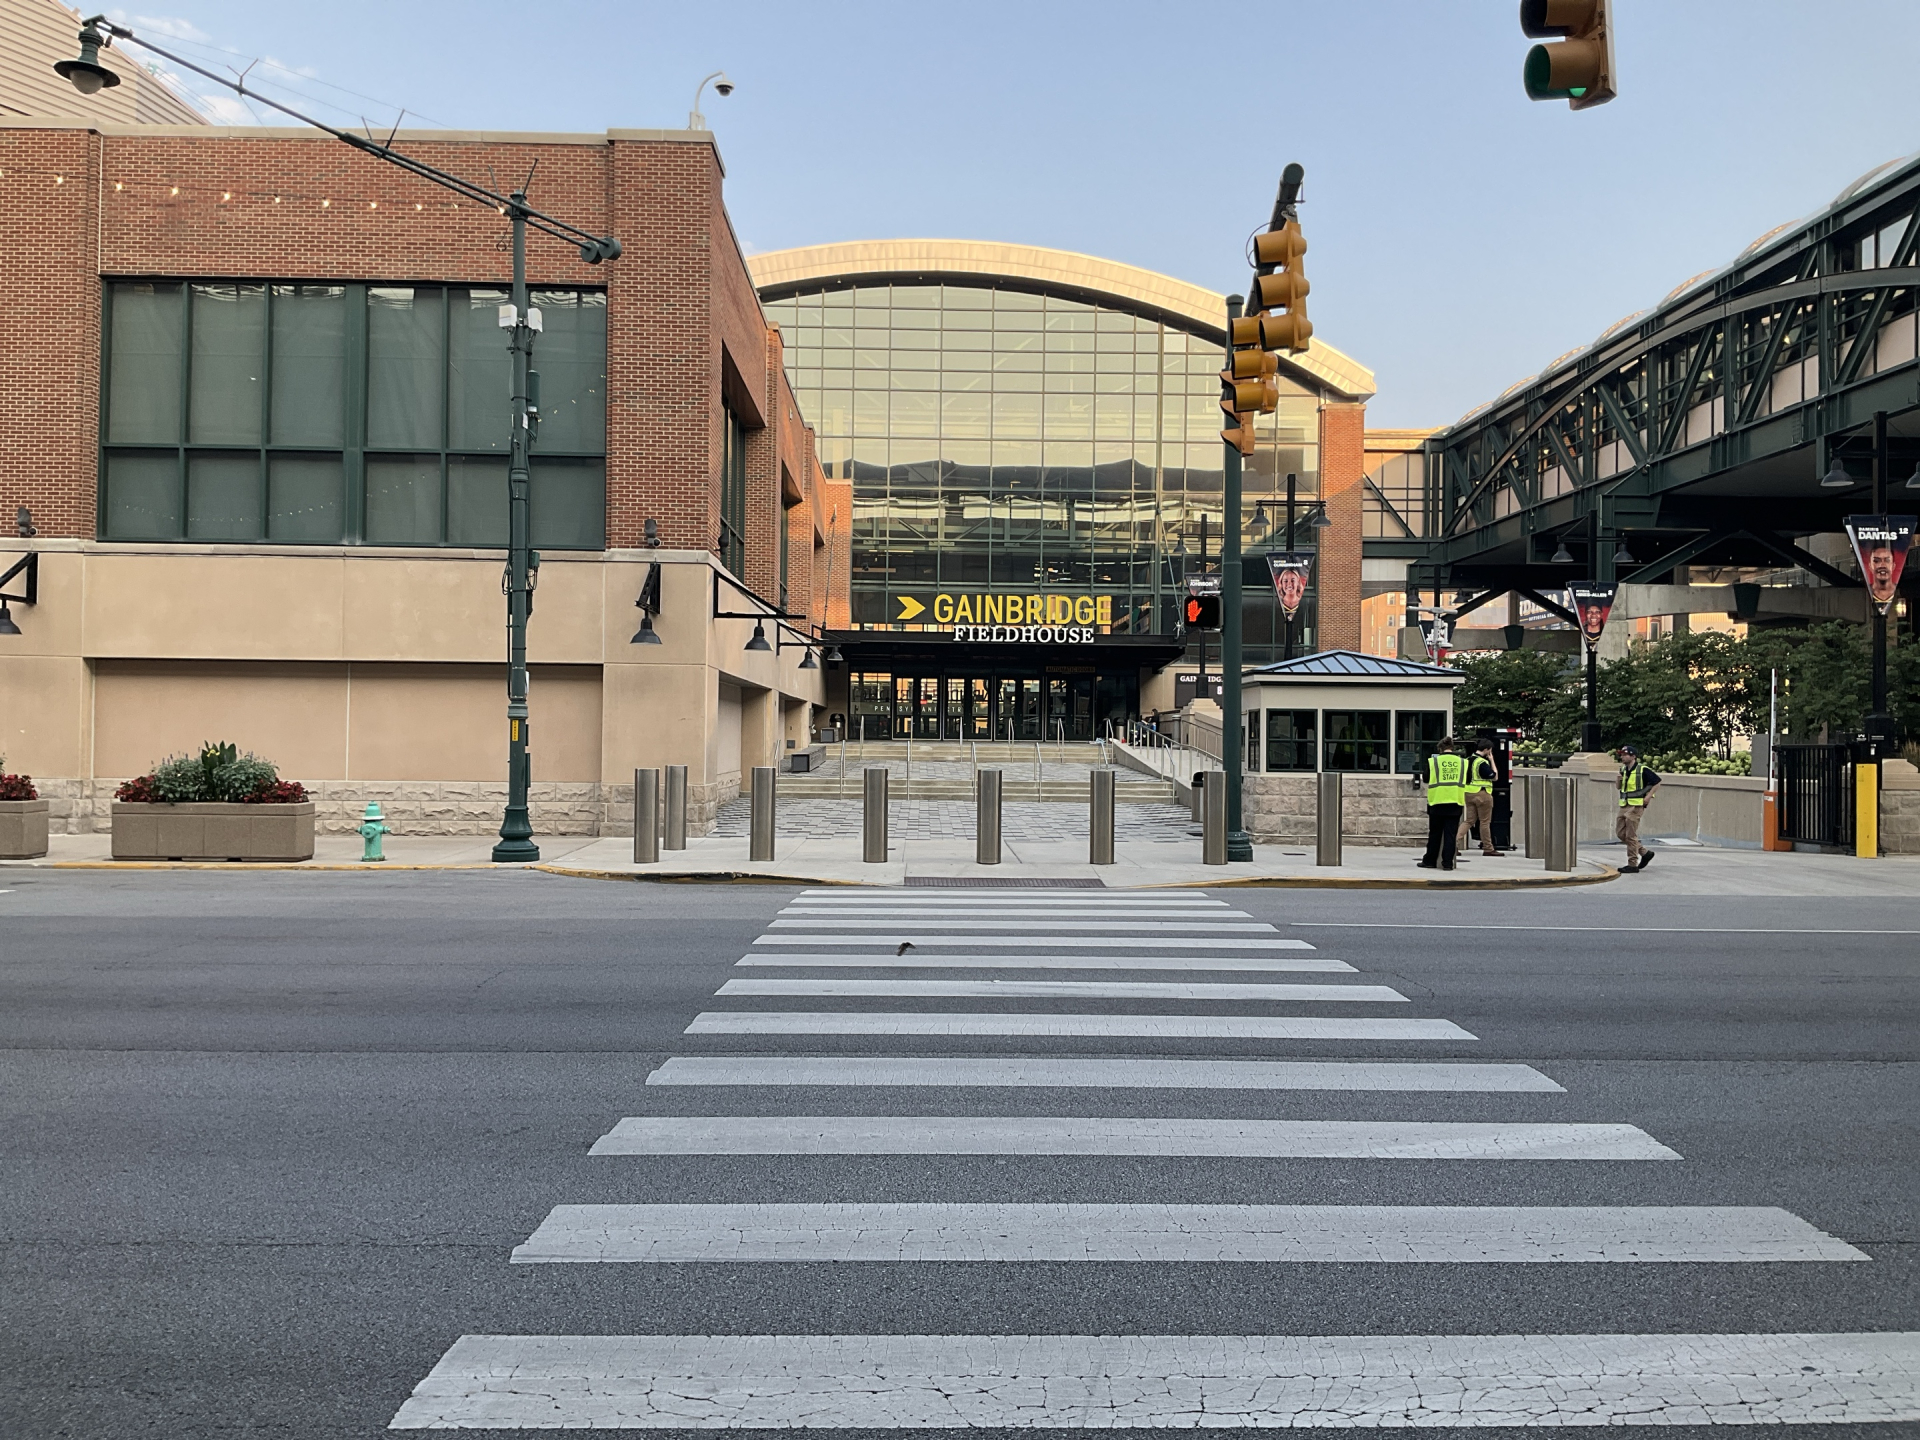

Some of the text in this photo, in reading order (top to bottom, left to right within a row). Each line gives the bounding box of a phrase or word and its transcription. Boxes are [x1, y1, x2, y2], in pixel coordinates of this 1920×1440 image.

[1858, 531, 1898, 540] DANTAS
[933, 594, 1112, 625] GAINBRIDGE
[952, 625, 1095, 644] FIELDHOUSE
[1441, 760, 1459, 768] CSC
[1442, 773, 1459, 781] STAFF
